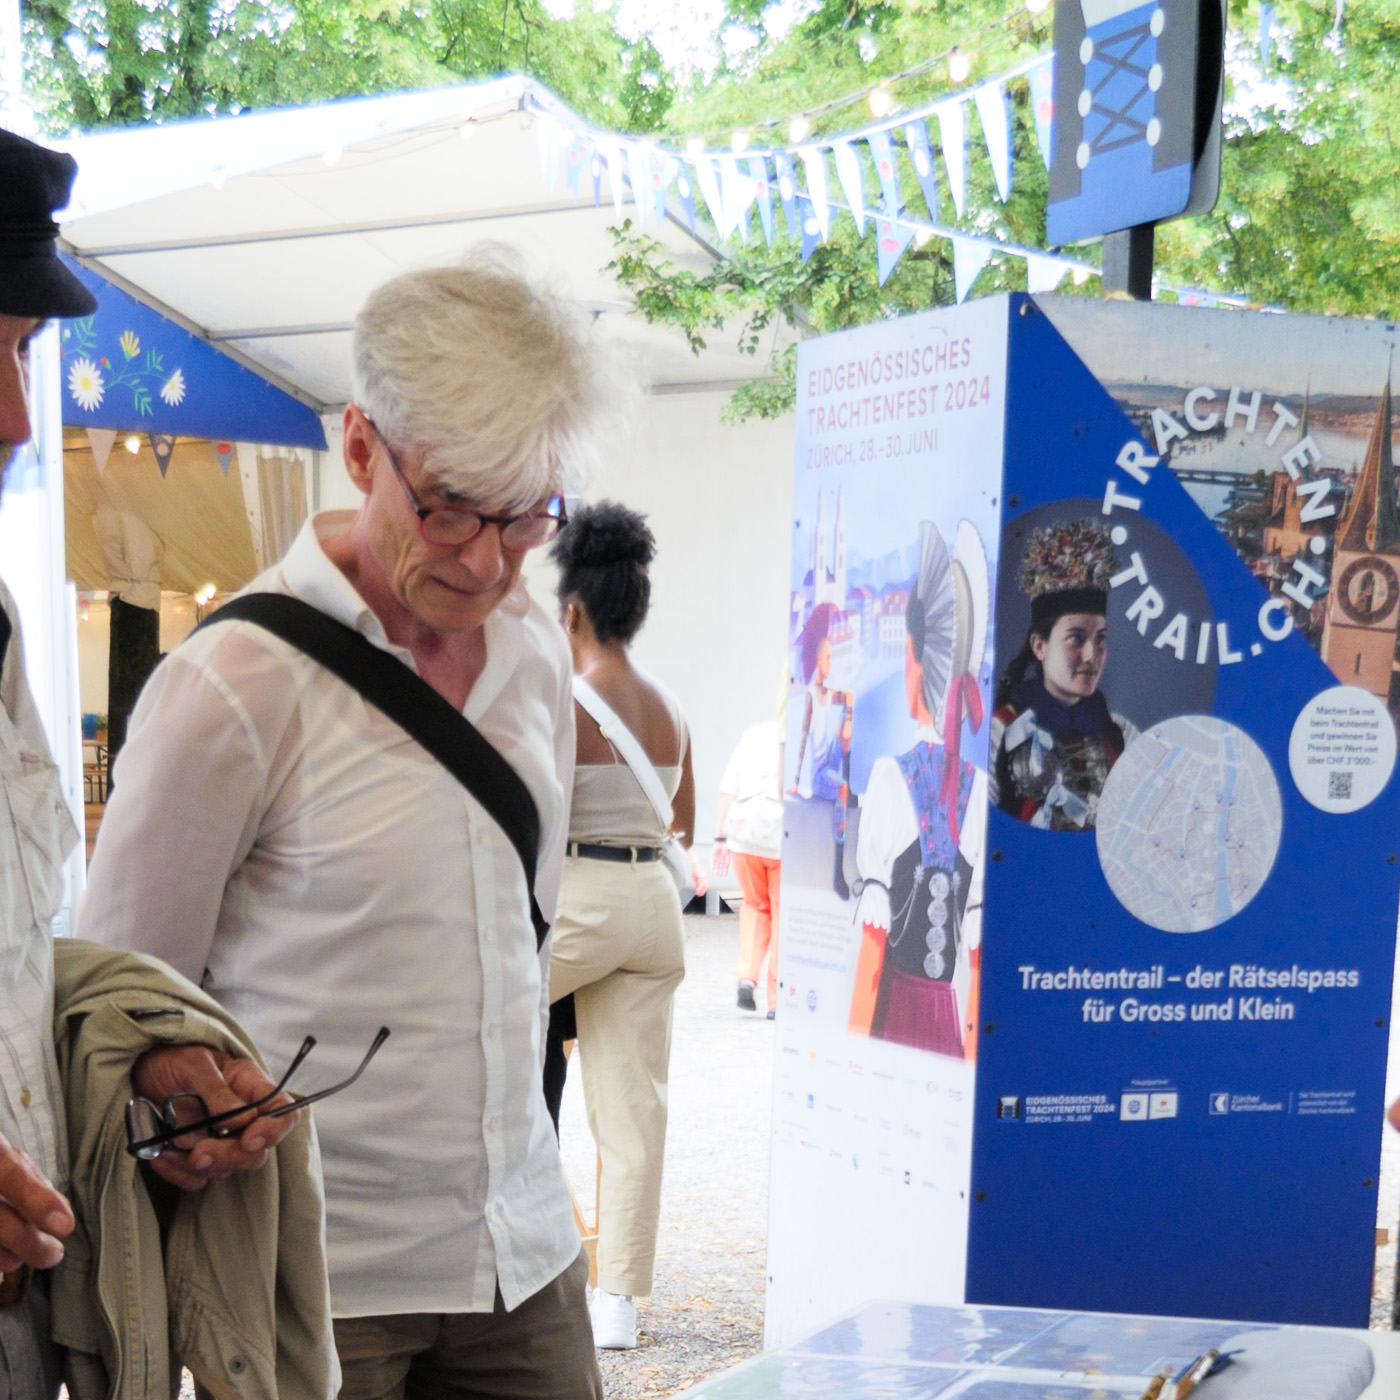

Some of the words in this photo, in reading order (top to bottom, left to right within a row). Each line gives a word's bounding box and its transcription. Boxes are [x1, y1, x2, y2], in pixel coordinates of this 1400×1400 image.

[808, 336, 971, 398] EIDGENÖSSISCHES
[808, 385, 939, 435] TRACHTENFEST
[944, 375, 991, 413] 2024
[806, 442, 857, 470] ZÜRICH,
[1018, 965, 1164, 990] Trachtentrail
[1185, 965, 1225, 989] der
[1228, 963, 1360, 993] Rätselspass
[1082, 998, 1115, 1023] für
[1119, 998, 1187, 1022] Gross
[1190, 997, 1234, 1021] und
[1238, 995, 1295, 1020] Klein
